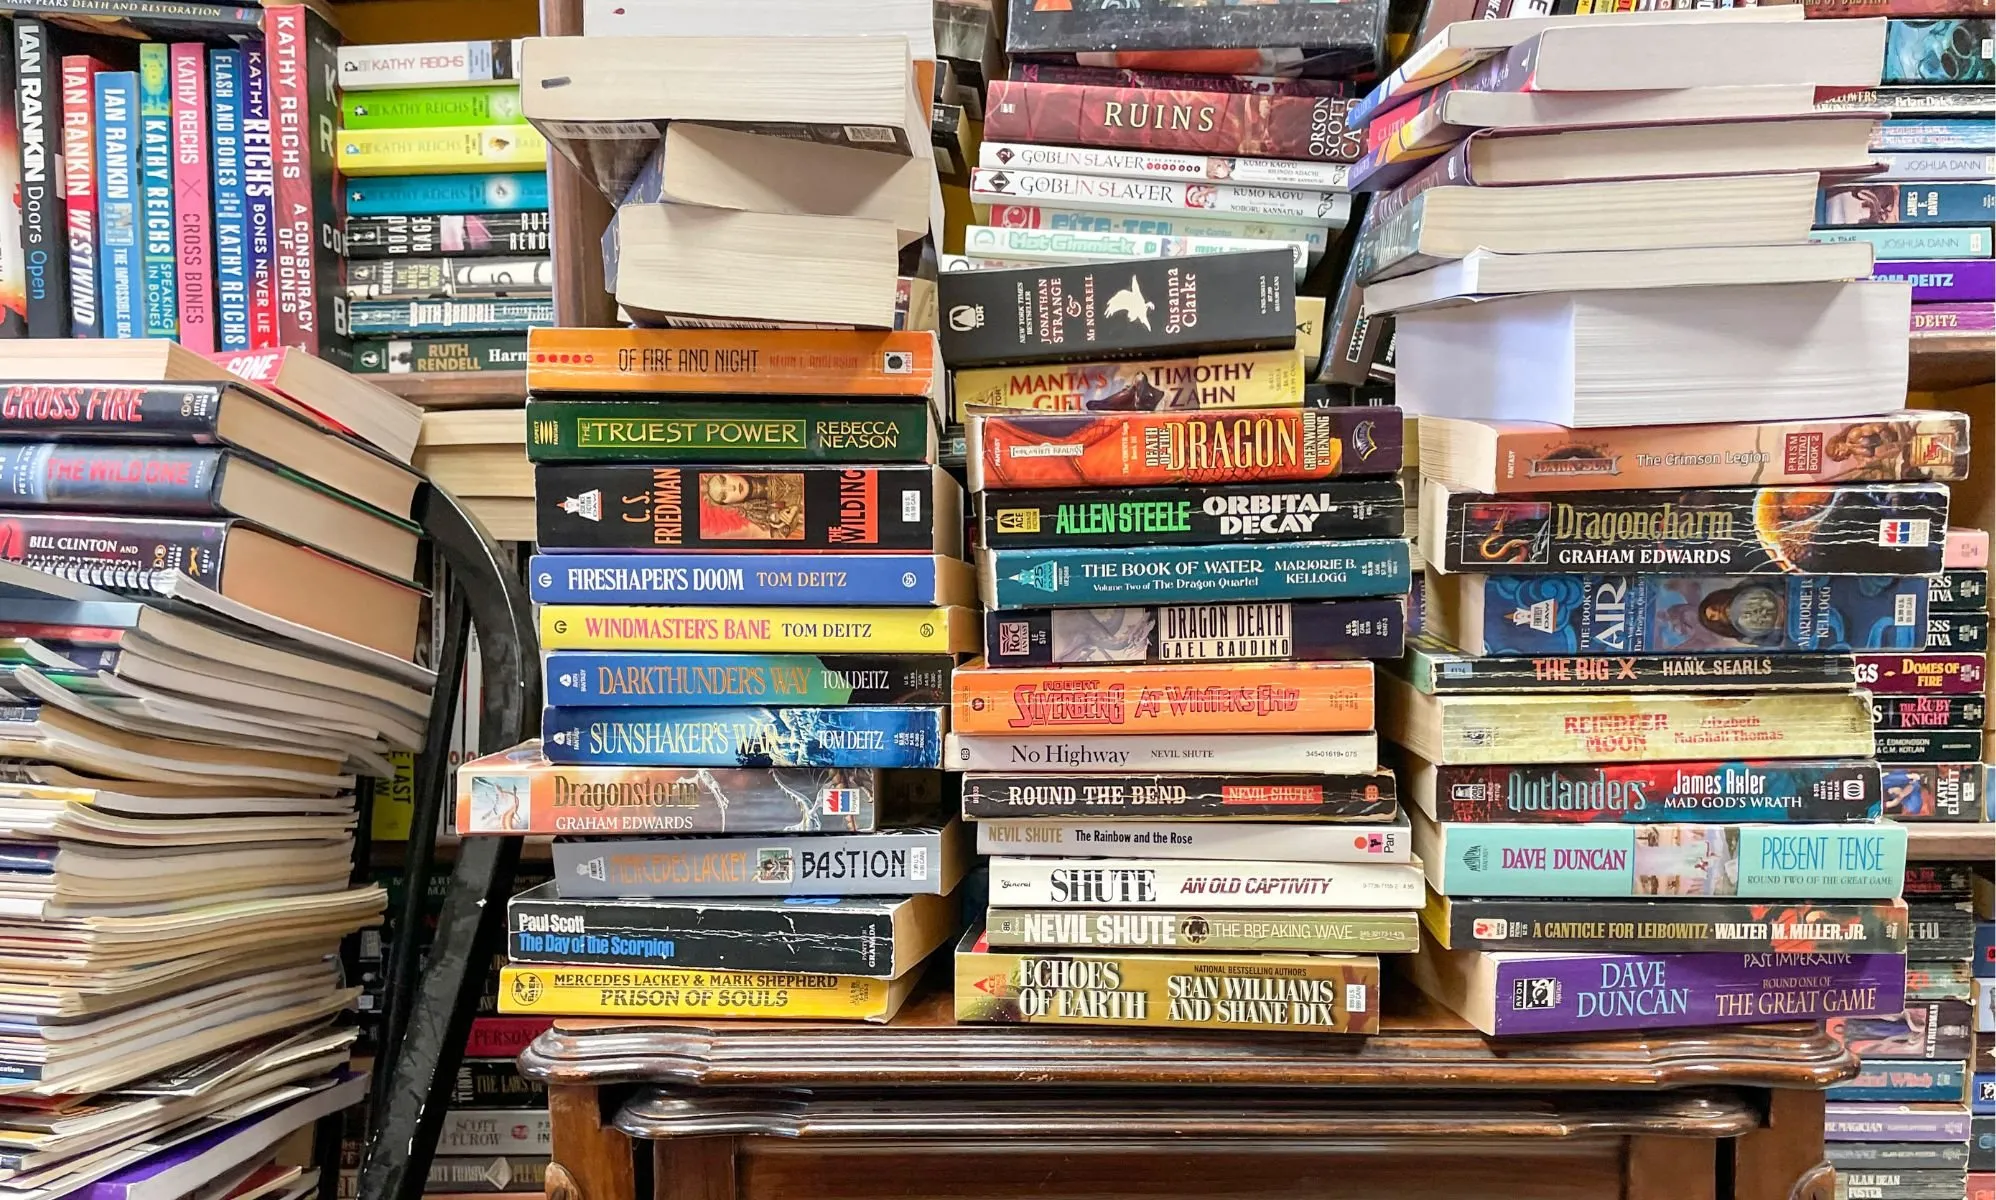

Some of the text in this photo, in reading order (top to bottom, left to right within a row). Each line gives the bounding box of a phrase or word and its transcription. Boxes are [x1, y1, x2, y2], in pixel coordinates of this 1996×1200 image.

[372, 59, 415, 71] KATHY
[420, 56, 464, 68] REICHS
[277, 16, 300, 179] KATHY REICHS
[382, 104, 420, 115] KATHY
[425, 103, 469, 114] REICHS
[1104, 102, 1215, 132] RUINS
[1309, 96, 1330, 156] ORSON
[1324, 97, 1345, 158] SCOTT
[104, 88, 129, 199] IAN RANKIN
[1905, 160, 1947, 171] JOSHUA
[1950, 159, 1981, 170] DANN
[63, 66, 95, 326] IAN RANKIN WESTWIND
[145, 120, 170, 254] KATHY REICHS
[1907, 192, 1918, 217] JAMES
[1928, 192, 1938, 216] DAVID
[388, 216, 407, 253] ROAD
[413, 216, 432, 252] RAGE
[1010, 232, 1134, 255] Hot Gimmick
[1882, 238, 1959, 249] JOSHUA DANN
[149, 266, 160, 327] IN BONES
[410, 302, 441, 326] RUTH
[443, 302, 495, 326] RENDELL
[1915, 315, 1958, 328] DEITZ
[417, 359, 480, 371] RENDELL
[619, 349, 759, 372] OF FIRE AND NIGHT
[1150, 362, 1256, 386] TIMOTHY
[2, 385, 147, 422] CROSS FIRE
[1170, 386, 1236, 410] ZAHN
[582, 423, 590, 443] THE
[1167, 418, 1299, 471] DRAGON
[1507, 450, 1515, 479] FANTASY
[1637, 450, 1770, 467] The Crimson Legion
[1788, 435, 1798, 472] PRISM
[1810, 445, 1818, 471] BOOK
[48, 459, 82, 481] THE
[89, 459, 142, 482] WILD
[145, 462, 191, 485] ONE
[622, 487, 651, 523] C. S.
[653, 469, 682, 544] FRIEDMAN
[840, 470, 866, 543] WILDING
[1056, 501, 1191, 534] ALLEN STEELE
[1556, 503, 1733, 544] Dragoncharm
[30, 536, 138, 554] BILL CLINTON AND
[1558, 549, 1731, 564] GRAHAM EDWARDS
[1168, 605, 1283, 639] DRAGON DEATH
[1594, 576, 1627, 650] AIR
[585, 617, 872, 640] WINDMASTER'S BANE TOM DEITZ
[1162, 639, 1288, 659] GAEL BAUDINO
[598, 667, 766, 694] DARKTHUNDER'S
[770, 667, 812, 694] WAY
[821, 671, 849, 689] TOM
[849, 670, 890, 690] DEITZ
[1533, 657, 1772, 681] THE BIG X HANK SEARLS
[1008, 680, 1125, 728] SILVERBERG
[1135, 687, 1163, 718] AT
[1166, 685, 1255, 718] WINTER'S
[1257, 685, 1300, 717] END
[1564, 713, 1669, 734] REINDEER
[1901, 713, 1950, 728] KNIGHT
[590, 722, 728, 754] SUNSHAKER'S
[733, 724, 778, 754] WAR
[816, 731, 844, 749] TOM
[845, 730, 884, 750] DEITZ
[552, 774, 699, 811] Dragonstorm
[1508, 768, 1766, 811] Outlanders James Axler
[556, 816, 693, 830] GRAHAM EDWARDS
[610, 850, 905, 884] MERCEDES LACKEY BASTION
[1502, 837, 1885, 871] DAVE DUNCAN PRESENT TENSE
[518, 913, 584, 934] Paul Scott
[1919, 922, 1939, 939] GOD
[519, 933, 674, 959] The Day of the Scorpion
[554, 974, 838, 988] MERCEDES LACKEY & MARK SHEPHERD
[1019, 959, 1120, 990] ECHOES
[1194, 964, 1307, 976] NATIONAL BESTSELLING AUTHORS
[1600, 961, 1667, 989] DAVE
[600, 990, 788, 1007] PRISON OF SOULS
[1167, 975, 1334, 1003] SEAN WILLIAMS
[1515, 982, 1524, 1008] AVON
[1019, 989, 1147, 1019] OF EARTH
[1577, 990, 1689, 1018] DUNCAN
[1714, 988, 1876, 1018] THE GREAT GAME
[456, 1119, 497, 1133] SCOTT
[452, 1133, 500, 1146] TUROW
[1849, 1175, 1900, 1185] ALAN DEAN
